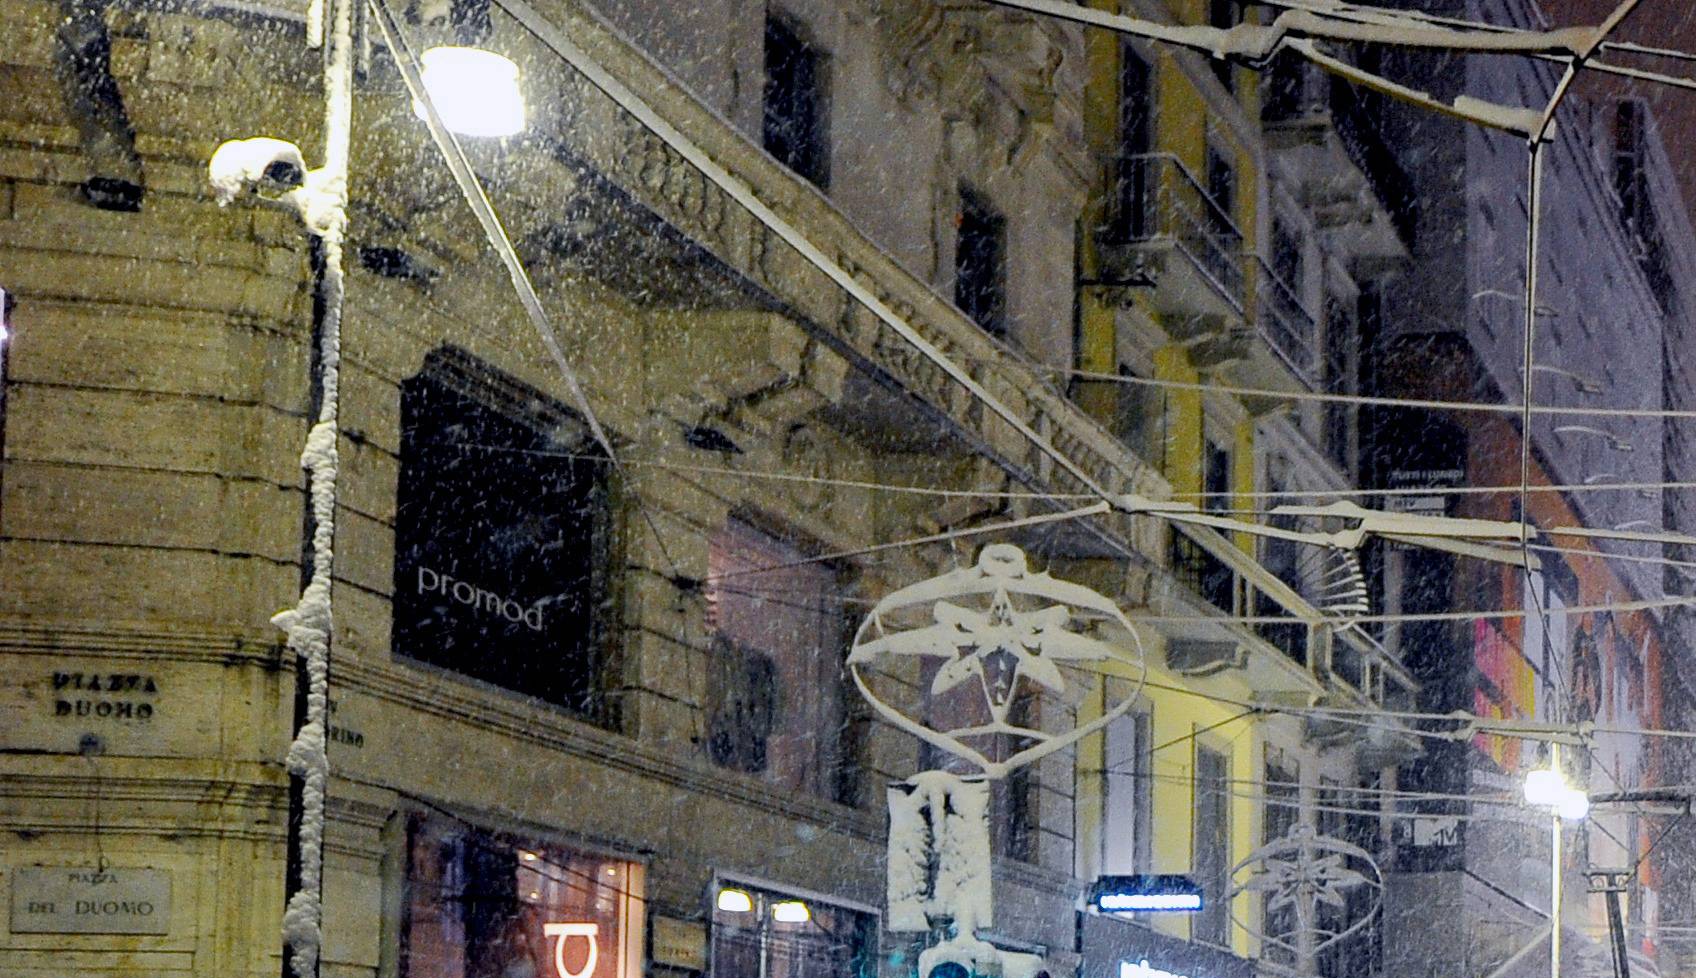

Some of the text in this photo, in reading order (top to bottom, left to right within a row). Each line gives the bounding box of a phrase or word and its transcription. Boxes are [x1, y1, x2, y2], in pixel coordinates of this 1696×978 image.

[418, 566, 544, 632] promod
[55, 699, 155, 719] DUOMO
[27, 900, 155, 916] DEL DUOMO
